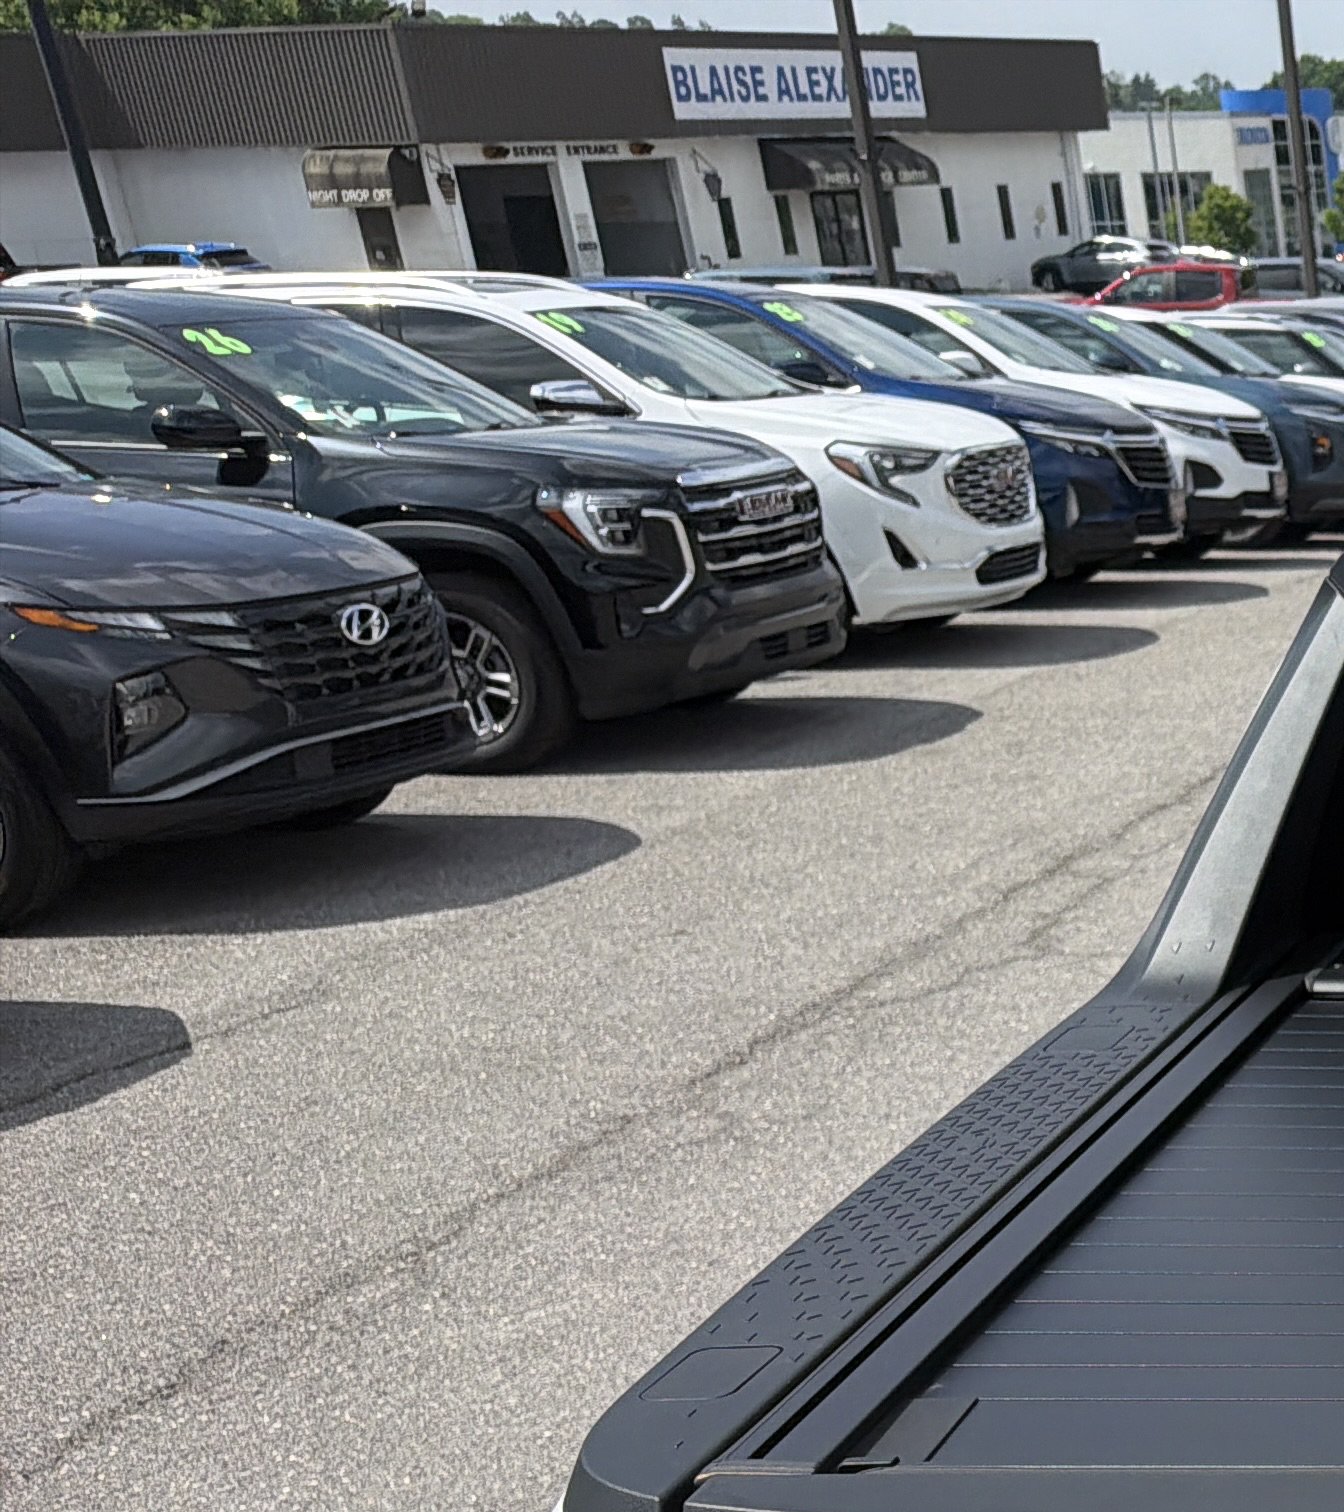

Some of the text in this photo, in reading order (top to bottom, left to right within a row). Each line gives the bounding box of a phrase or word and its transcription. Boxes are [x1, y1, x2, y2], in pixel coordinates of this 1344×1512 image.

[671, 64, 769, 103] BLAISE
[512, 143, 619, 158] SERVICE ENTRANCE
[308, 187, 394, 203] NIGHT DROP OFF
[182, 327, 253, 355] 26
